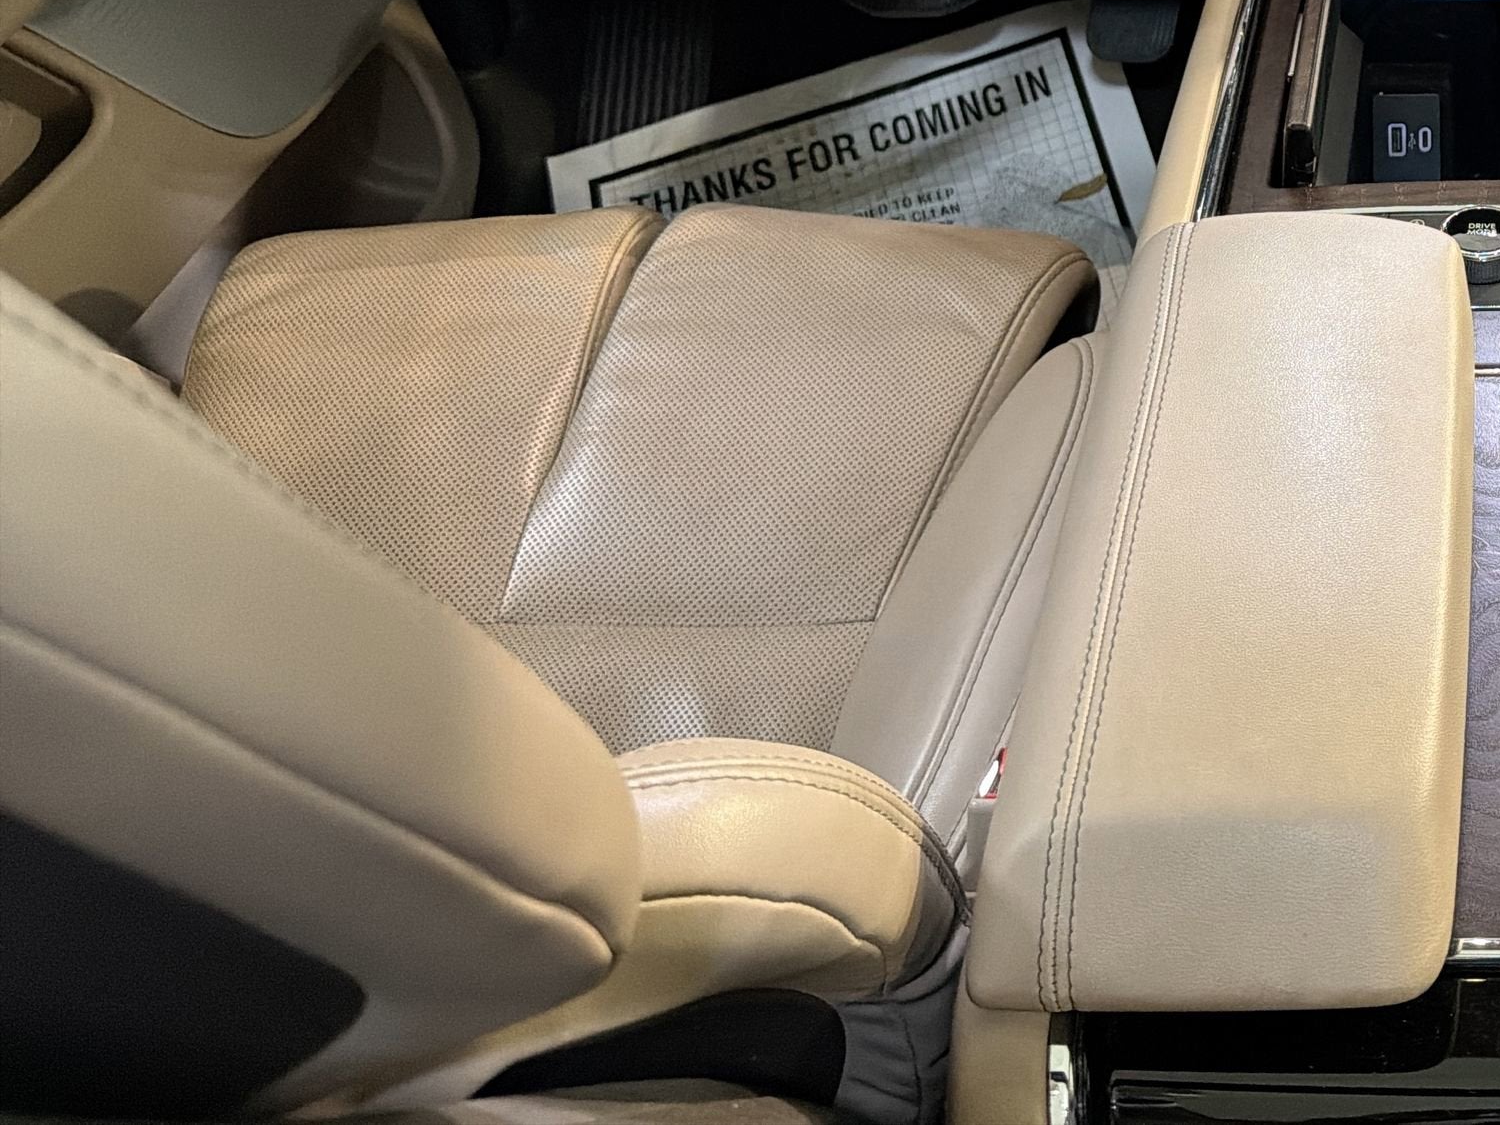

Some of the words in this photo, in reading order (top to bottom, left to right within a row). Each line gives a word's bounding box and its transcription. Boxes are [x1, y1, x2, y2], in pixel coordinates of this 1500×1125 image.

[784, 132, 861, 182] FOR
[868, 82, 1008, 153] COMING
[1014, 65, 1053, 107] IN
[1468, 222, 1496, 230] DRIVE
